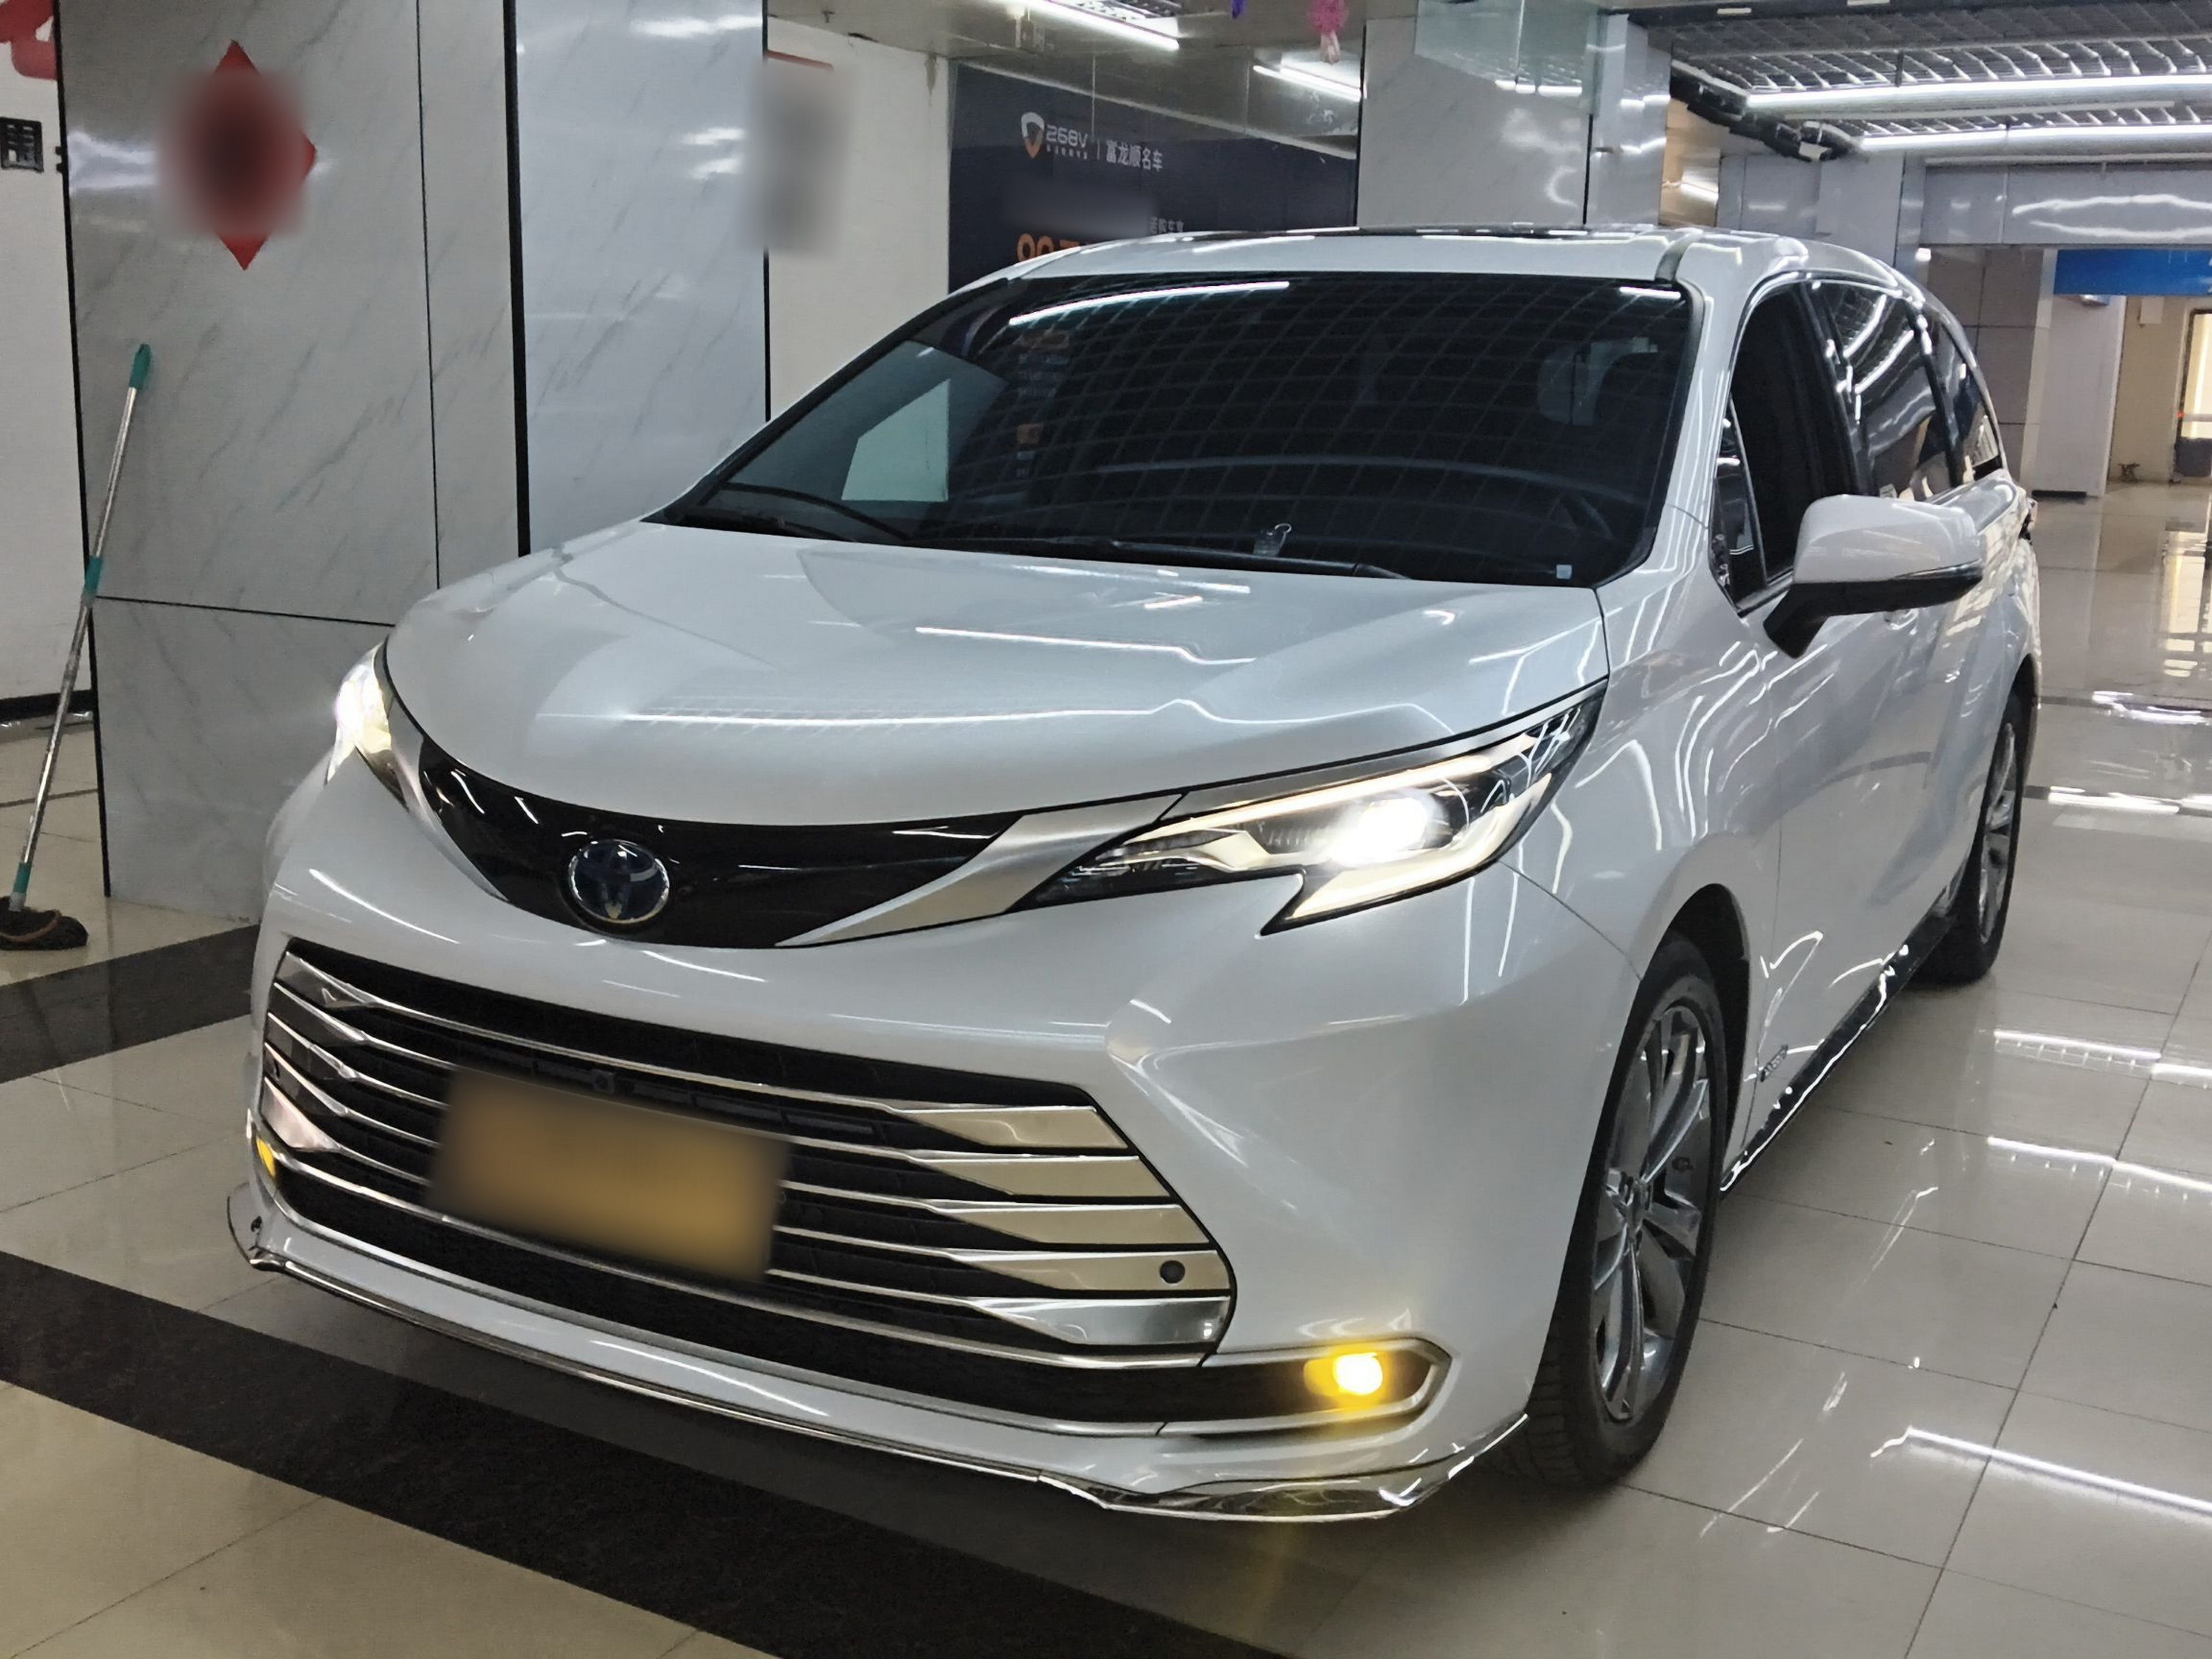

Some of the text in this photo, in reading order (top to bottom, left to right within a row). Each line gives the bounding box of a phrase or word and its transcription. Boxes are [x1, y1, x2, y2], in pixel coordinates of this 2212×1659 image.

[1046, 124, 1089, 149] 268V
[1105, 139, 1163, 172] 富龙顺名车
